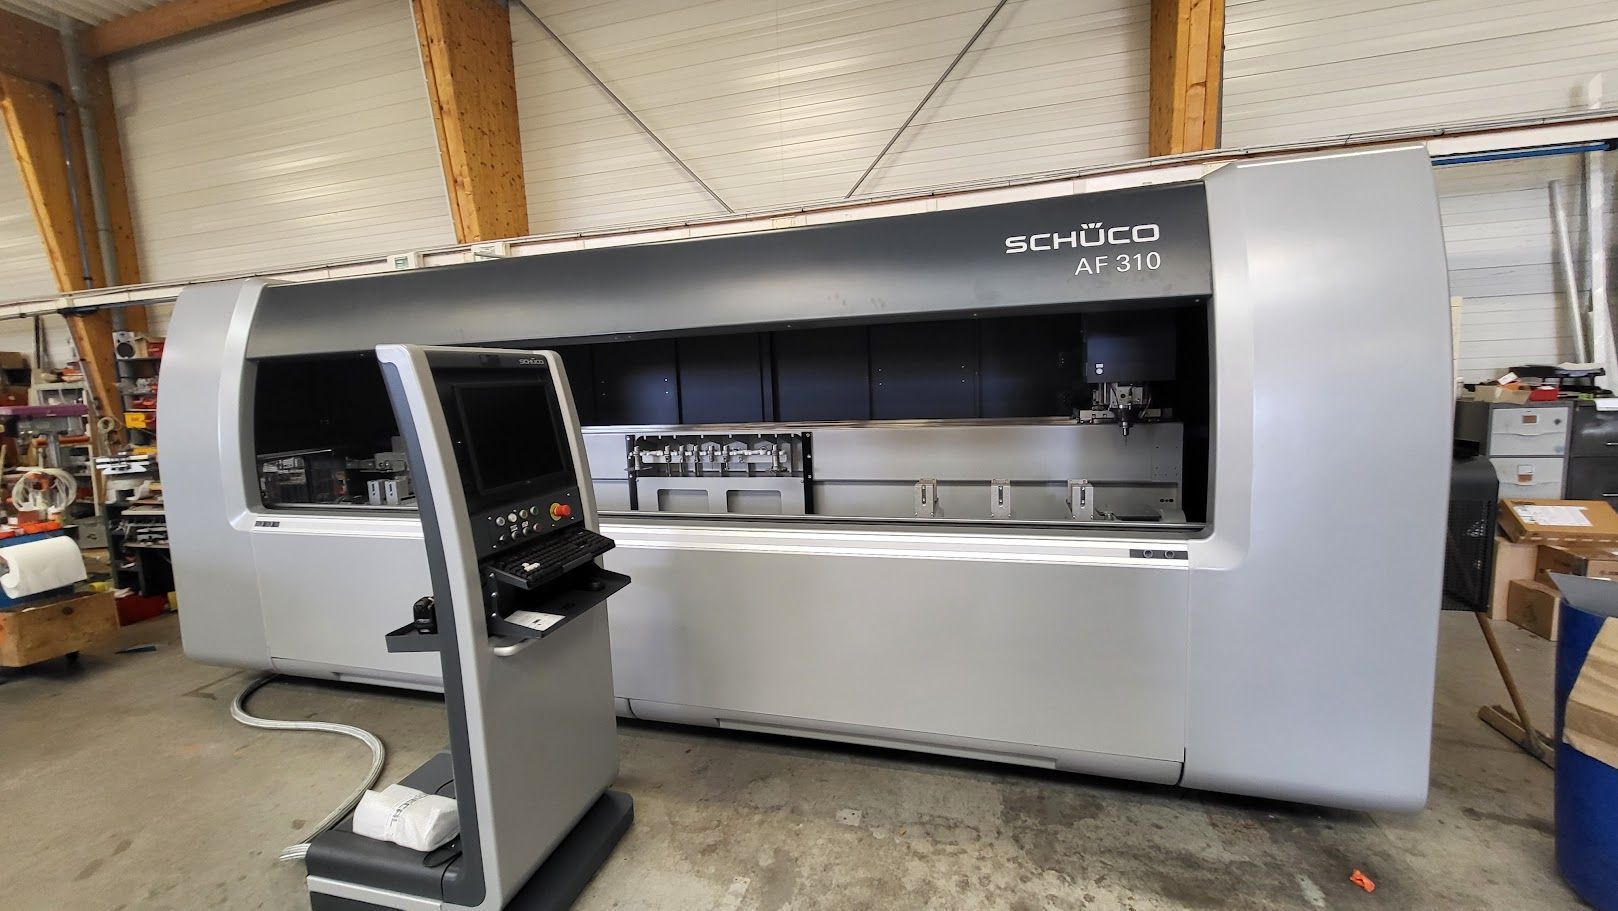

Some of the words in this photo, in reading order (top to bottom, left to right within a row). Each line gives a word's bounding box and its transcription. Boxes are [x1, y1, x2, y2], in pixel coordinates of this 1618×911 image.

[1005, 222, 1160, 254] SCHÜCO
[1074, 255, 1108, 276] AF
[1116, 251, 1161, 272] 310
